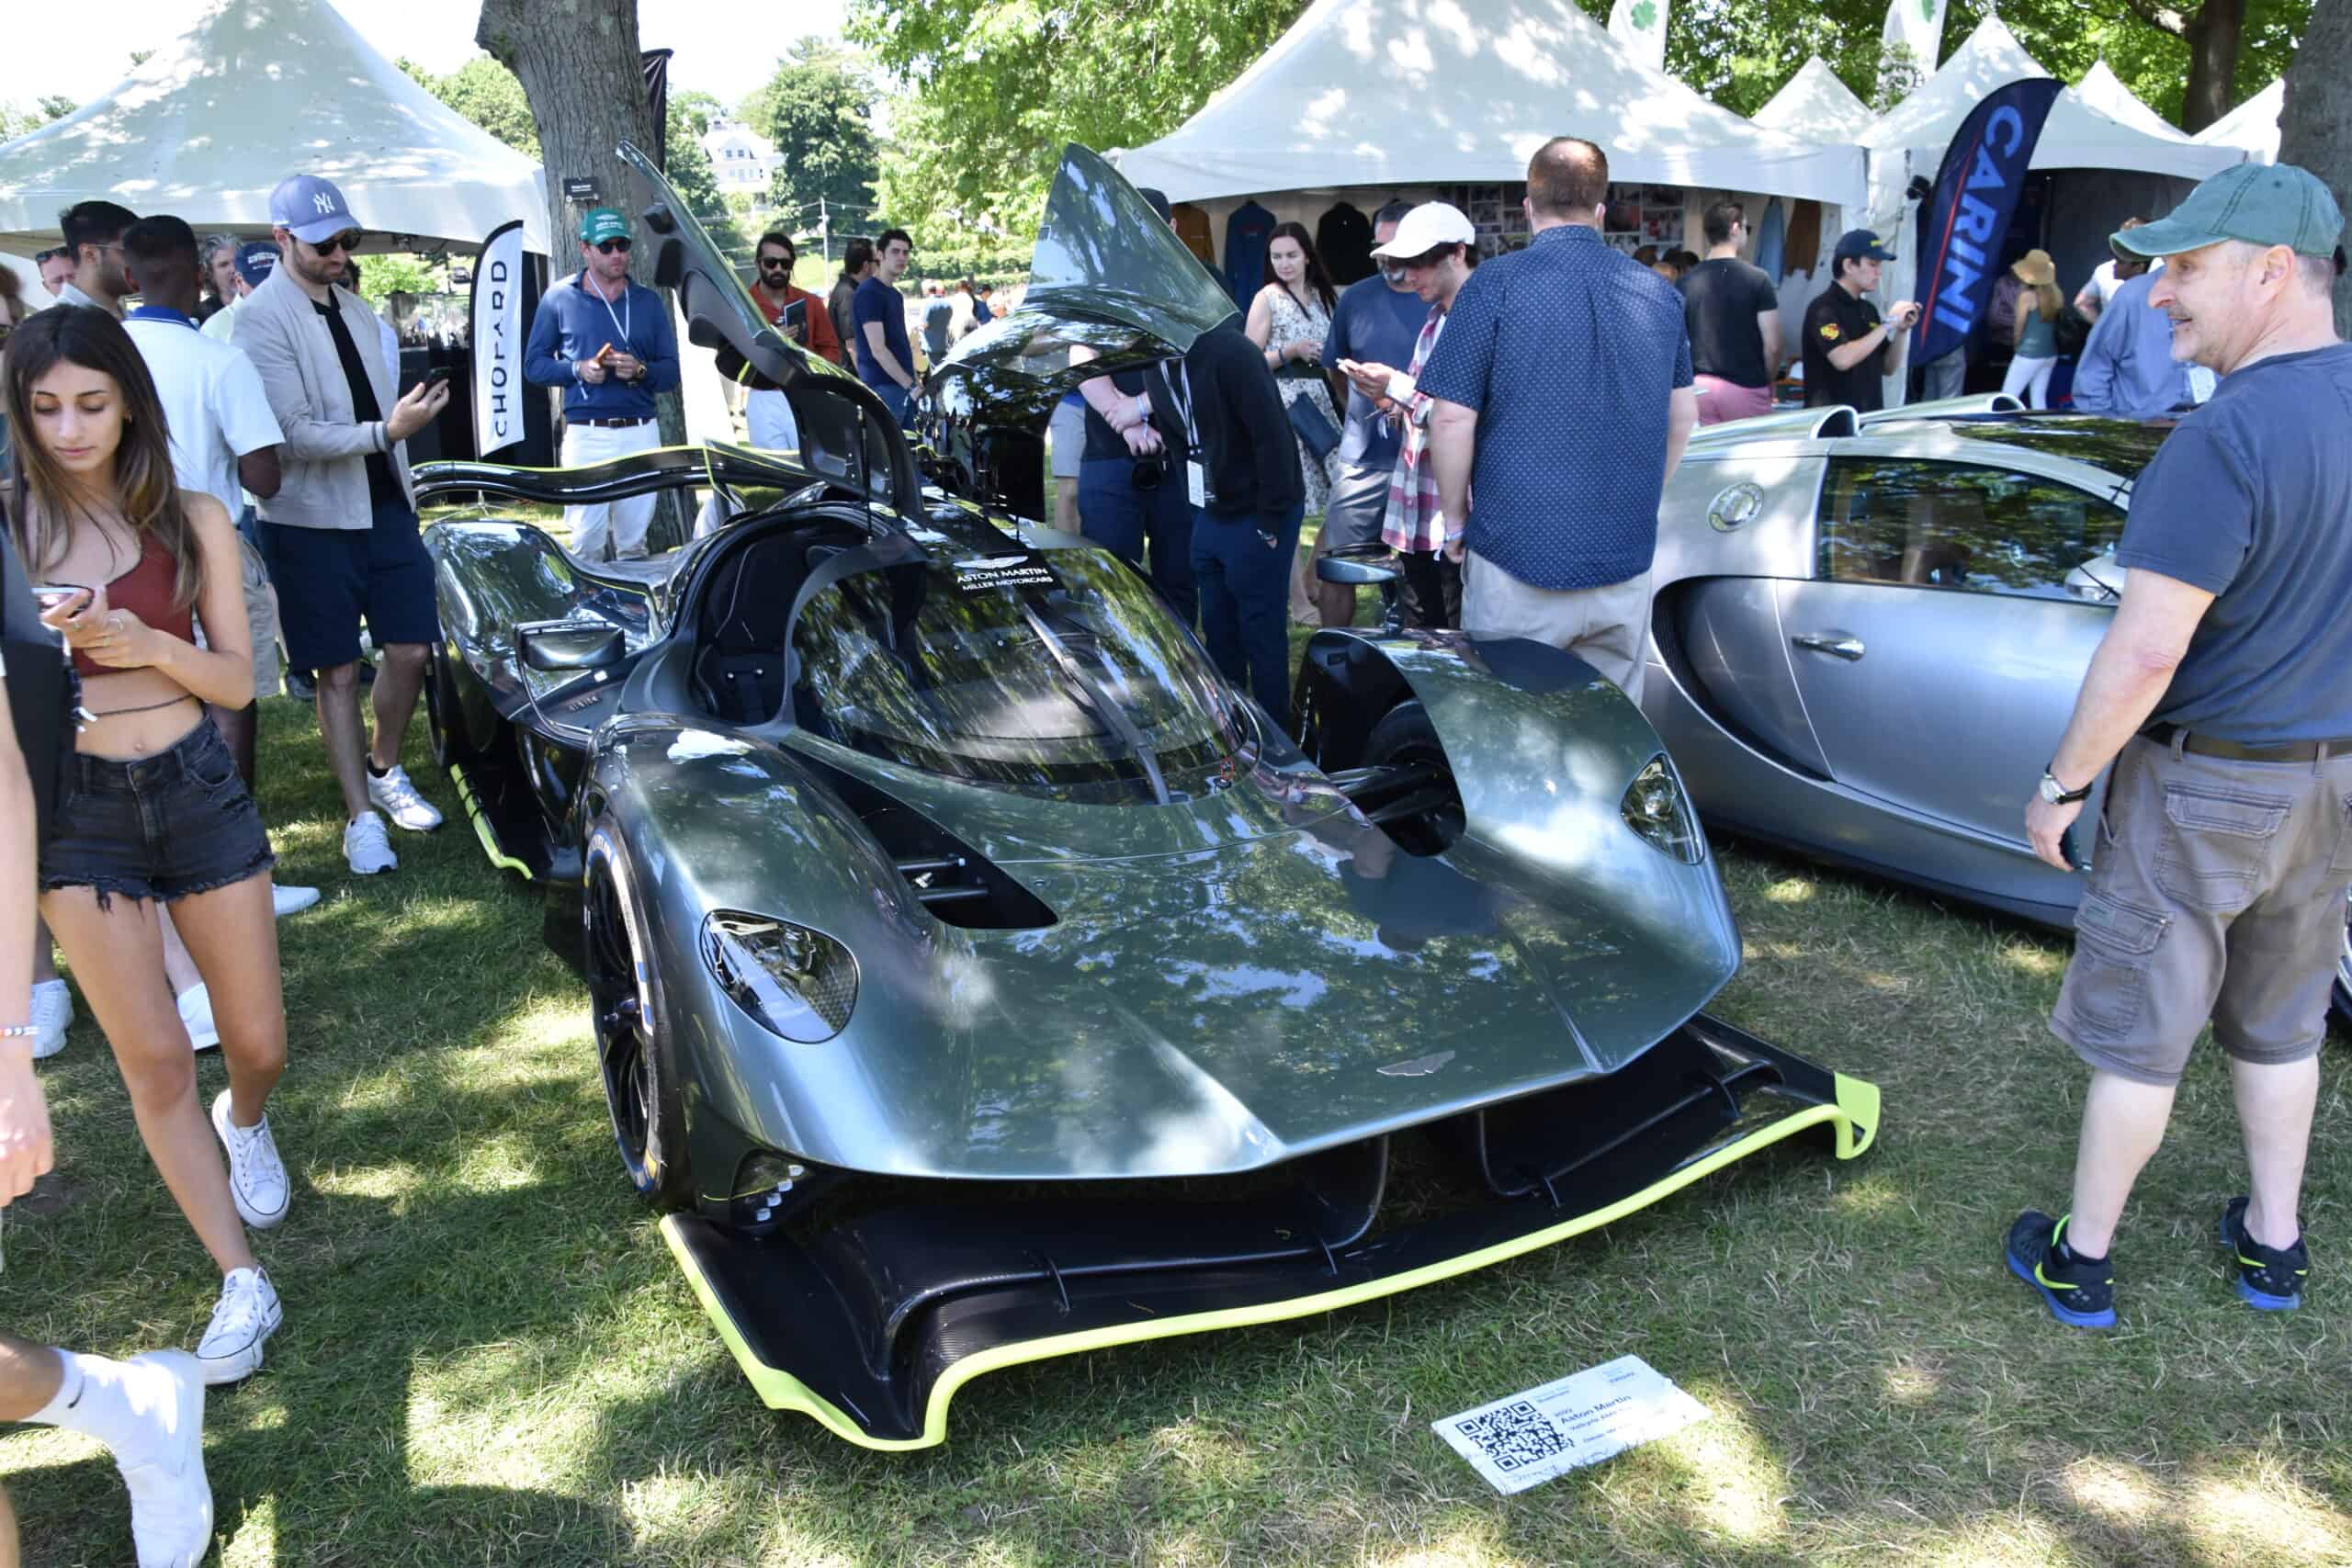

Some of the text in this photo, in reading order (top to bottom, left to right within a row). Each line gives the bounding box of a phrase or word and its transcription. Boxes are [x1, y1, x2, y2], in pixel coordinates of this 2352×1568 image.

[312, 191, 336, 214] NY
[1933, 105, 2024, 334] CARINI
[956, 568, 1048, 583] ASTON MARTIN
[1560, 1409, 1595, 1426] Aston
[1593, 1395, 1633, 1412] Martin
